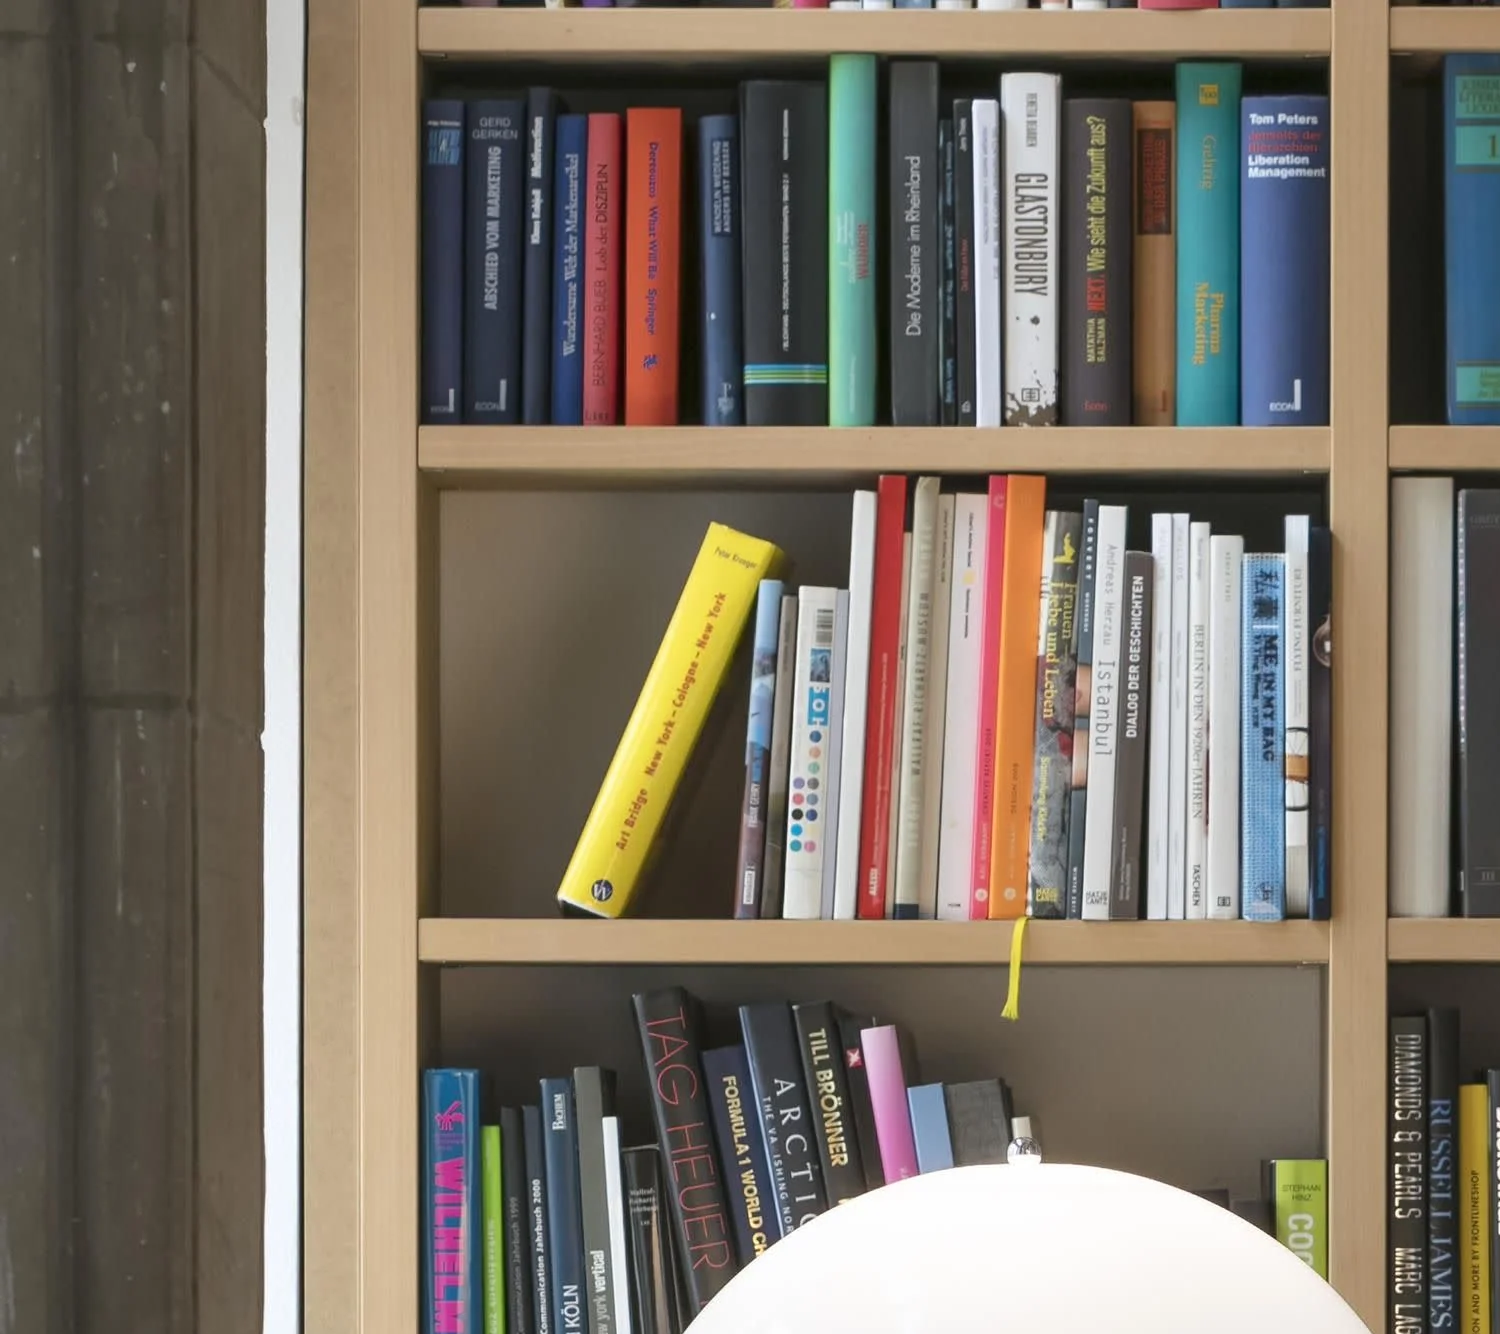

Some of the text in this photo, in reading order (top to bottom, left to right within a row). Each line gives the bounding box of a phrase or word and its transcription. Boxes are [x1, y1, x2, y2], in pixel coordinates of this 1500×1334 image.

[473, 129, 518, 140] GERKEN
[1249, 113, 1318, 124] Tom Peters
[1487, 135, 1499, 158] 1
[1087, 116, 1106, 271] Wie sieht die Zukunft aus?
[1248, 154, 1309, 165] Liberation
[1248, 166, 1325, 179] Management
[484, 146, 502, 310] ABSCHIED VOM MARKETING
[905, 156, 921, 336] Die Moderne im Rheinland
[1014, 173, 1048, 297] GLASTONBURY
[1126, 576, 1144, 738] DIALOG DER GESCHICHTEN
[615, 592, 727, 850] Art Bridge New York Cologne New York
[1095, 660, 1116, 756] Istanbul
[1191, 864, 1201, 906] TASCHEN
[808, 1028, 848, 1167] TILL BRÖNNER
[647, 1007, 730, 1270] TAG HEUER
[722, 1075, 763, 1230] FORMULA 1 WORLD
[1470, 1170, 1480, 1246] FRONTLINESHOP
[1471, 1250, 1480, 1260] BY
[1472, 1264, 1480, 1290] MORE
[560, 1285, 580, 1328] KÖLN
[1472, 1294, 1480, 1314] AND
